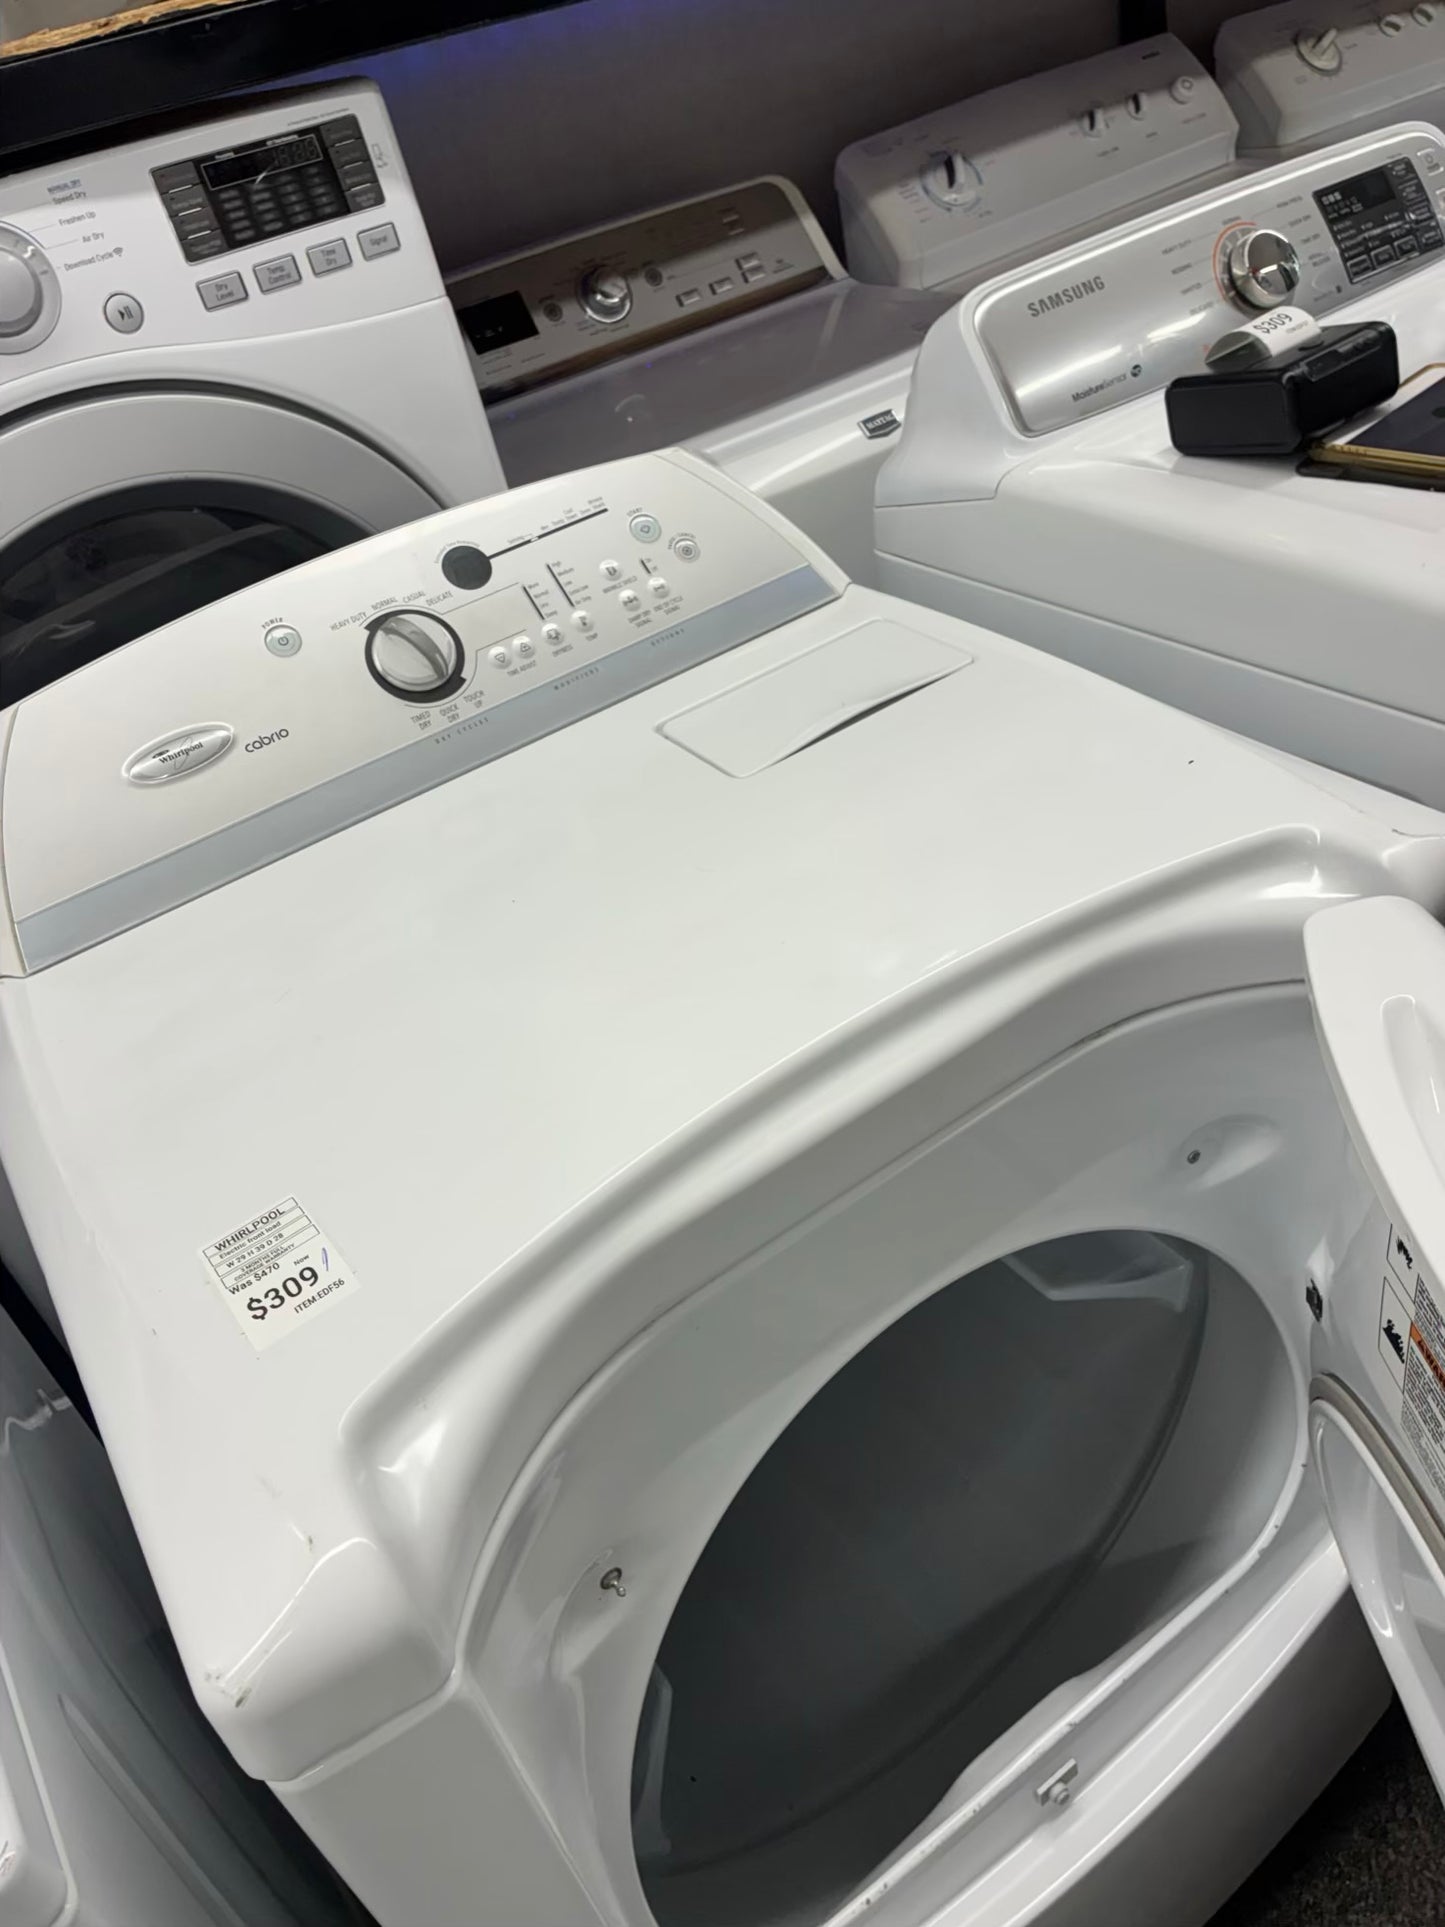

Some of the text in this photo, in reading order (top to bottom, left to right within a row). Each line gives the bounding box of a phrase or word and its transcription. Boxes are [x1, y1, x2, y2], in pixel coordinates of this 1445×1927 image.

[58, 211, 96, 226] Freshen Up
[92, 232, 104, 240] Dry
[64, 251, 114, 272] Download Cycle
[215, 283, 228, 293] Dry
[216, 290, 235, 301] Level
[1027, 276, 1106, 317] SAMSUNG
[1253, 312, 1293, 334] $309
[866, 413, 896, 429] MAYTAG
[371, 596, 398, 611] NORMAL
[402, 590, 426, 604] CASUAL
[425, 590, 454, 607] DELICATE
[329, 611, 368, 632] HEAVY DUTY
[463, 690, 484, 703] TOUCH
[474, 700, 483, 709] UP
[410, 711, 431, 724] TIMED
[439, 703, 460, 717] QUICK
[447, 712, 460, 723] DRY
[418, 720, 432, 731] DRY
[244, 728, 289, 753] cabrio
[158, 741, 204, 764] Whirlpool
[214, 1207, 286, 1252] WHIRLPOOL
[219, 1221, 282, 1260] Electric front load
[226, 1261, 235, 1269] W
[235, 1254, 246, 1263] 29
[247, 1249, 255, 1257] H
[254, 1243, 265, 1251] 39
[273, 1232, 284, 1241] 28
[270, 1245, 284, 1255] FULL
[234, 1243, 295, 1282] COVERAGE WARRANTY
[293, 1254, 310, 1267] Now
[228, 1262, 280, 1295] Was $470
[246, 1266, 319, 1321] $309
[293, 1278, 346, 1314] ITEM:EDF56
